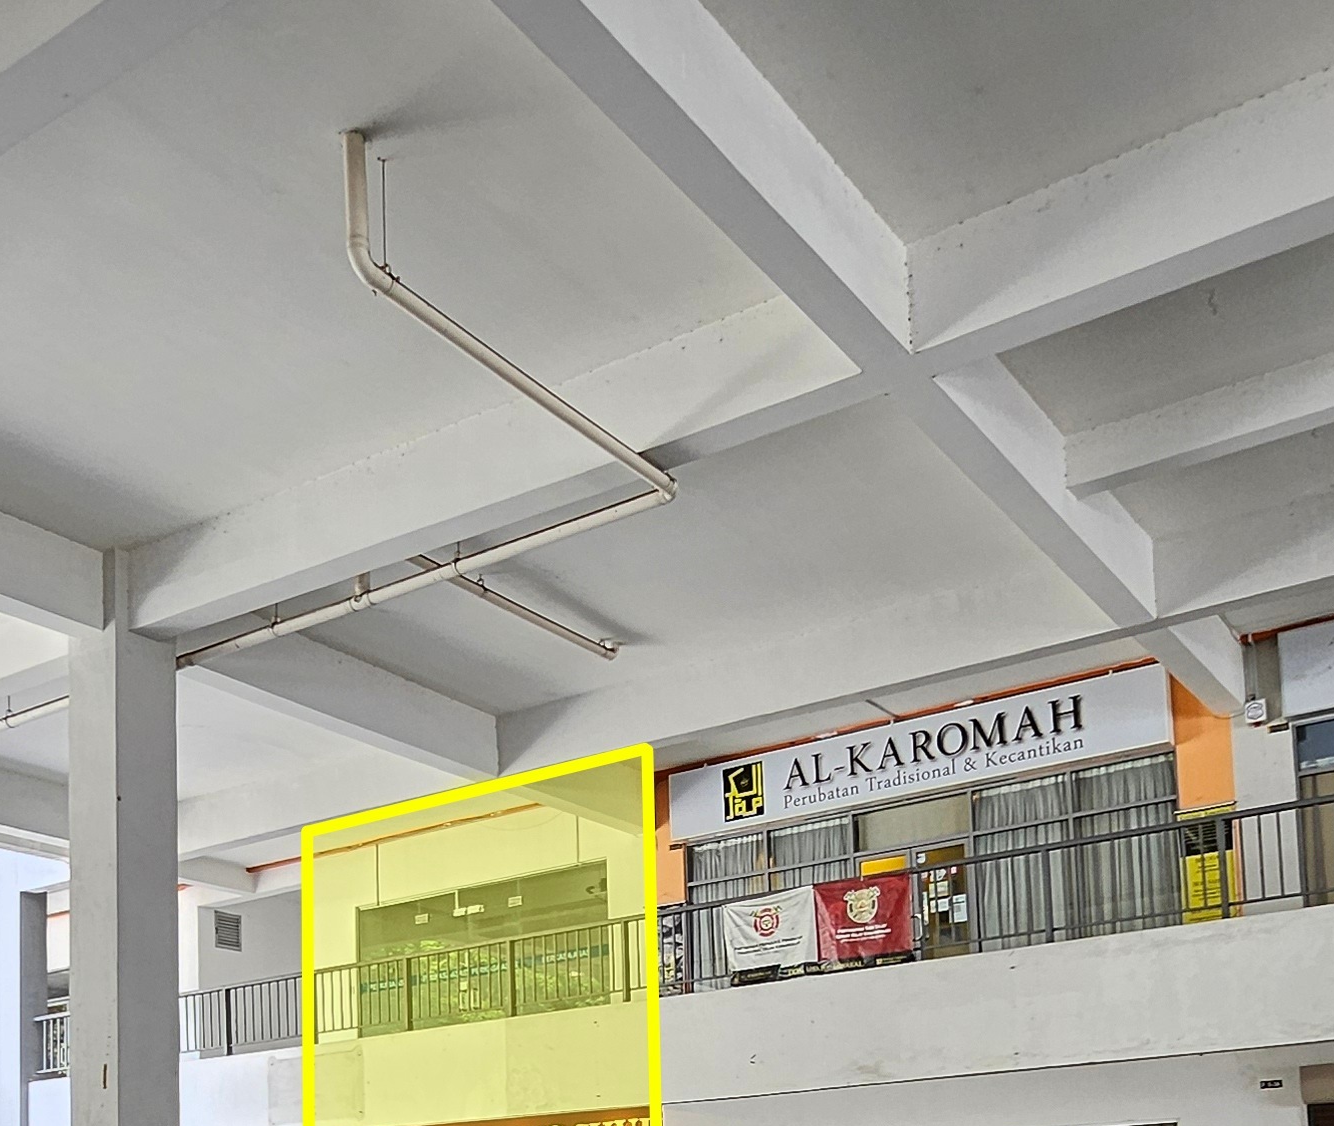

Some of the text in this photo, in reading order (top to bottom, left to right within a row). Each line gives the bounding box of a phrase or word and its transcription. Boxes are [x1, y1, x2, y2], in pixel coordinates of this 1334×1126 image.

[783, 736, 1085, 810] Perubatan Tradisional & Kecantikan
[784, 695, 1083, 791] AL-KAROMAH
